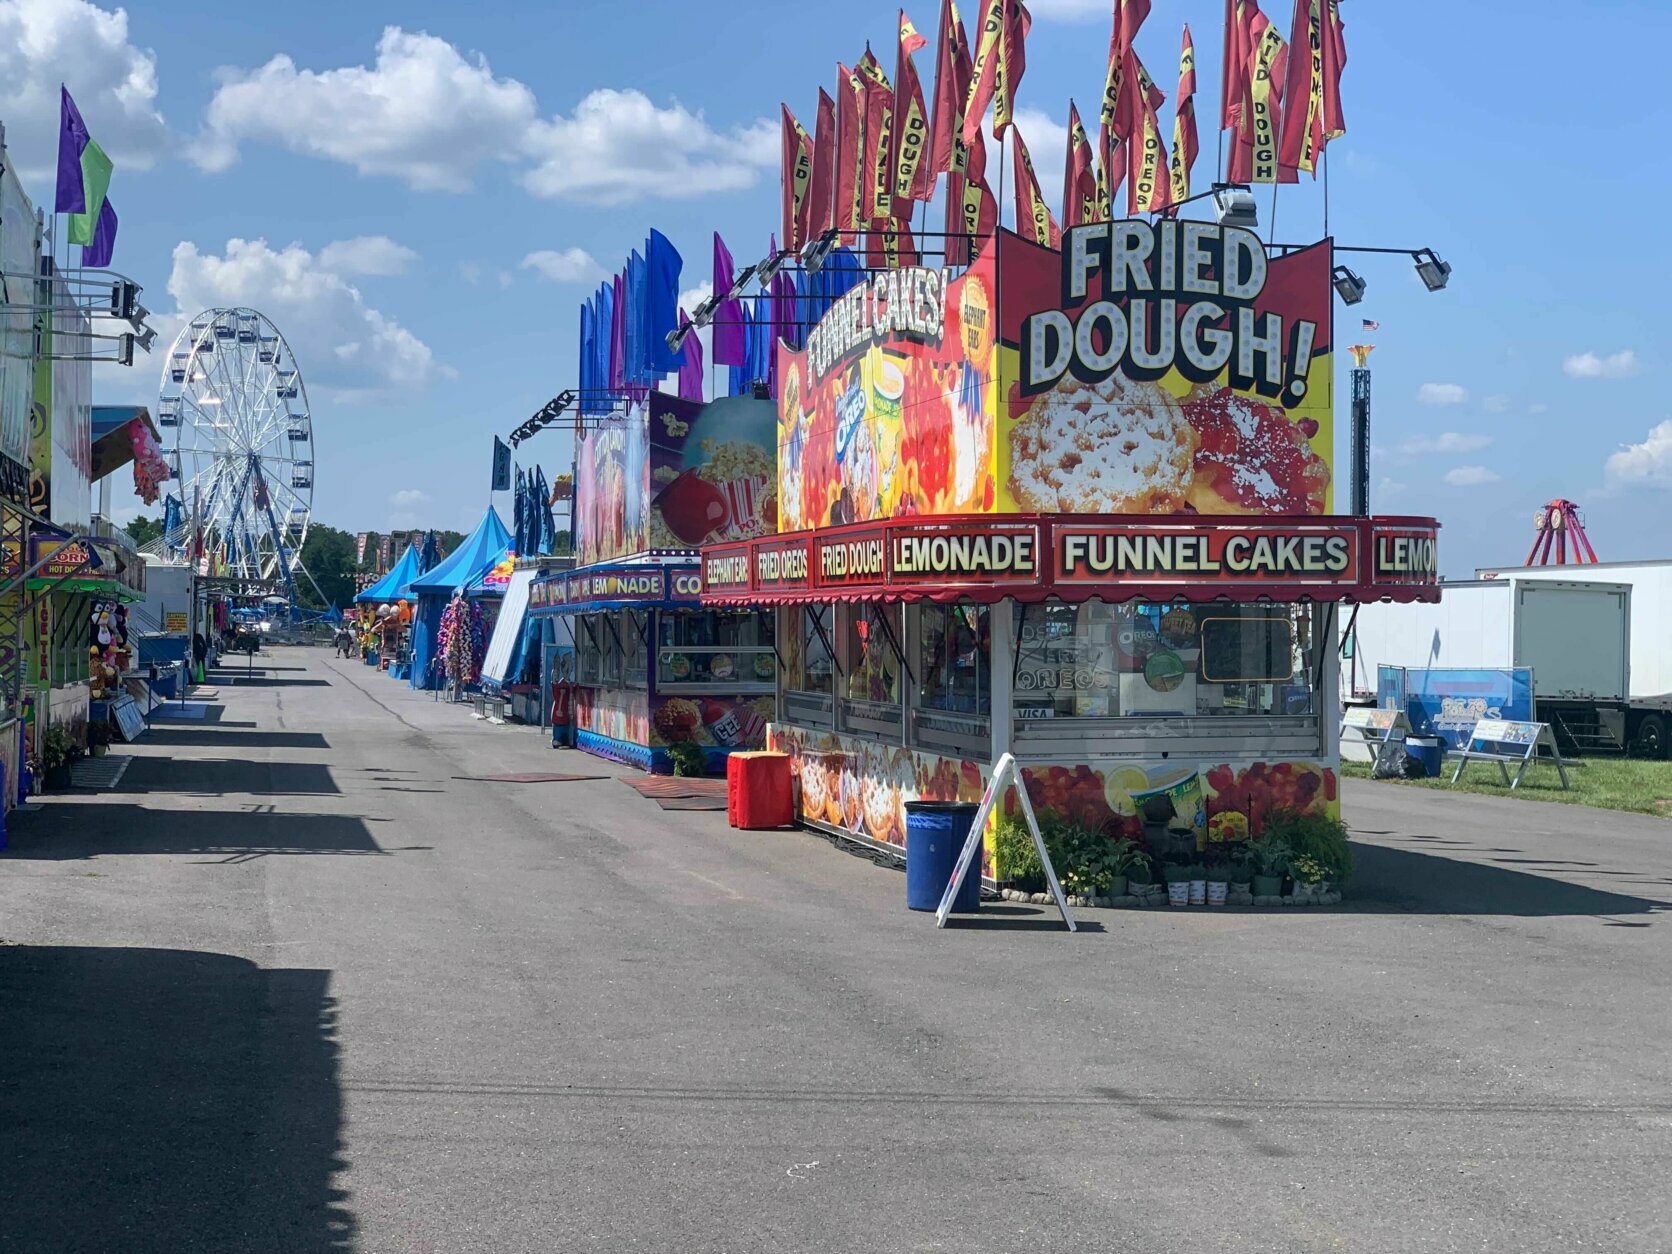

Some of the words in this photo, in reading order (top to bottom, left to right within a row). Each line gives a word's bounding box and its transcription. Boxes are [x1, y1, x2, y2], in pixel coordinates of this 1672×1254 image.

[898, 117, 925, 191] DOUGH
[1255, 102, 1273, 178] DOUGH
[1137, 138, 1158, 205] OREOS
[1071, 219, 1268, 300] FRIED
[807, 281, 873, 391] FUNNEL
[873, 268, 948, 340] CAKES!
[964, 304, 986, 330] ELEPHANT
[967, 328, 980, 350] EARS
[1030, 298, 1317, 397] DOUGH!
[835, 389, 866, 454] OREO
[49, 564, 62, 573] HOT
[707, 557, 735, 584] ELEPHANT
[758, 552, 781, 580] FRIED
[781, 548, 808, 579] OREOS
[821, 542, 847, 577] FRIED
[848, 539, 883, 575] DOUGH
[893, 535, 1034, 572] LEMONADE
[1066, 536, 1220, 571] FUNNEL
[1225, 535, 1349, 572] CAKES
[40, 641, 48, 680] TEA
